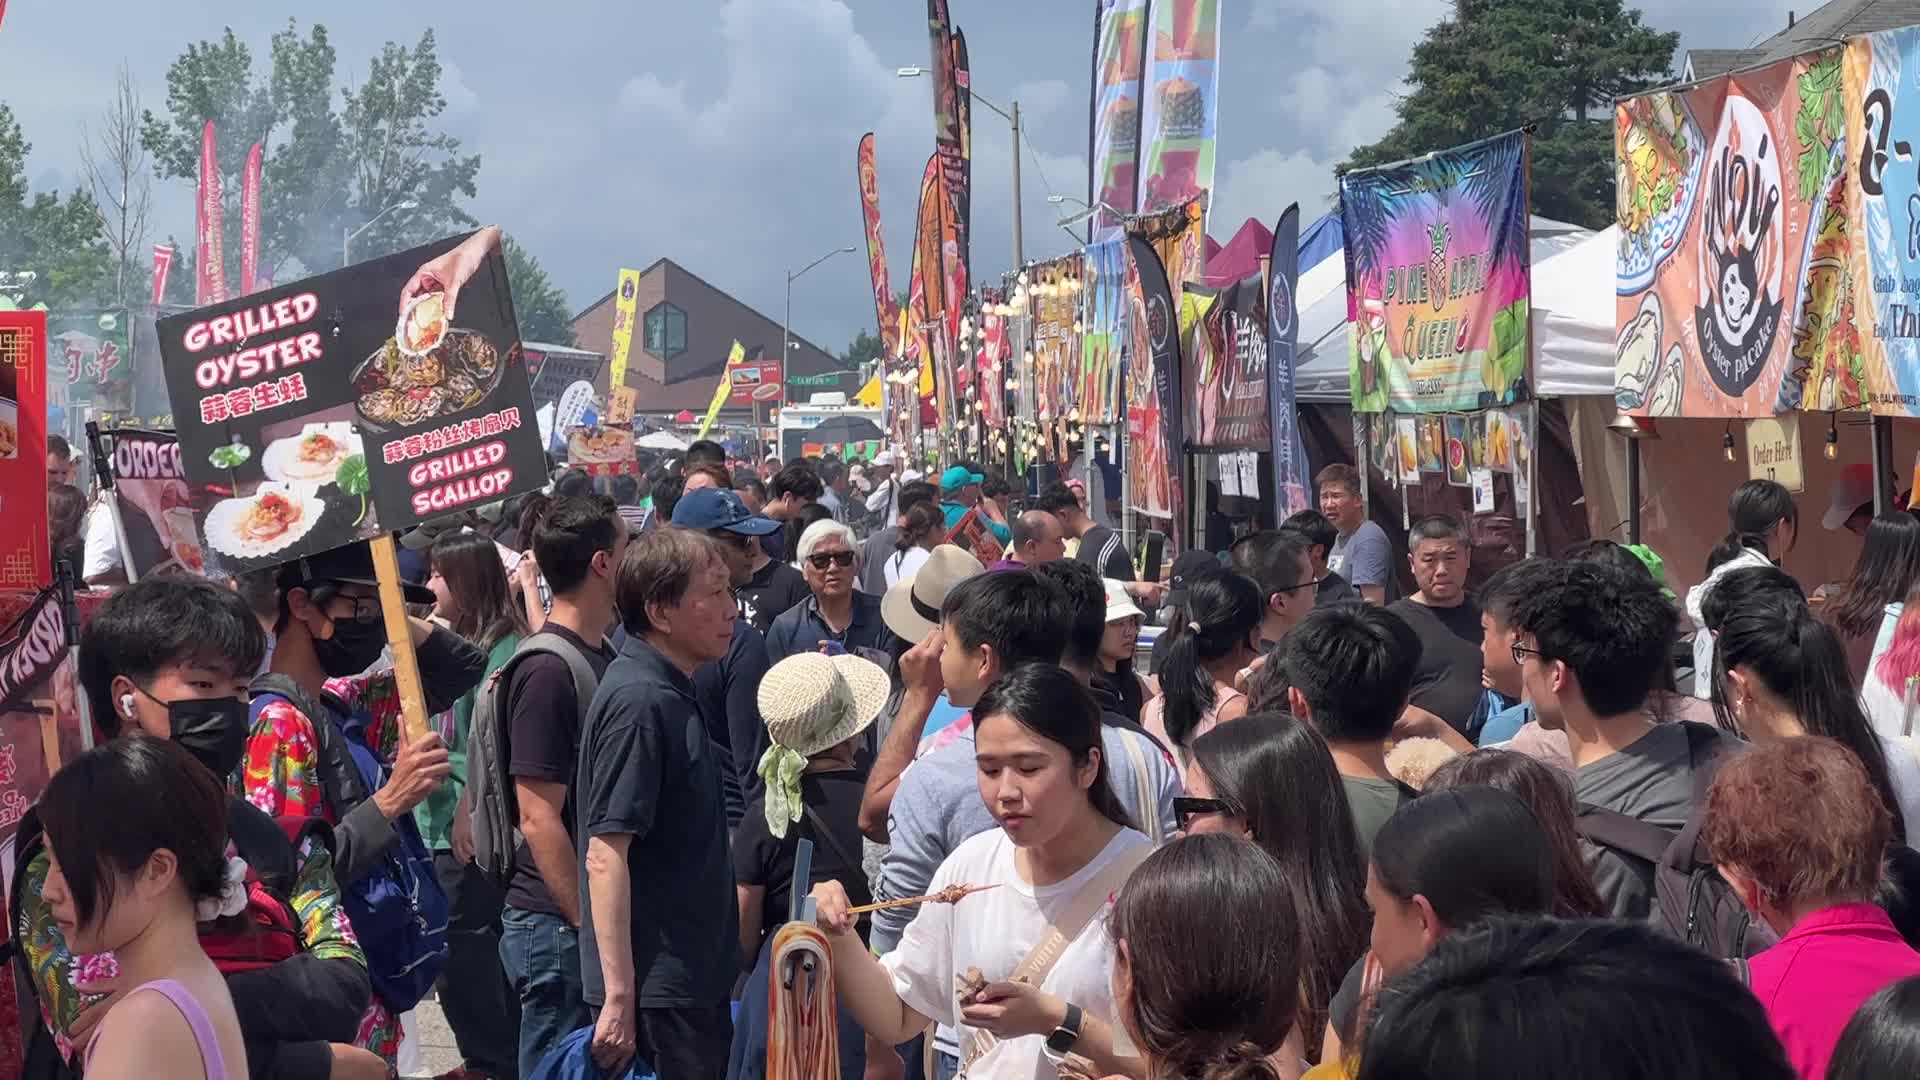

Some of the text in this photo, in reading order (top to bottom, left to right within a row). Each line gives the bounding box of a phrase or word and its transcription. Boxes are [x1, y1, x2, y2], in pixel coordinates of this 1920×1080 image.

[1384, 264, 1428, 305] PINE
[1873, 273, 1896, 294] Grab
[184, 292, 318, 352] GRILLED
[1403, 317, 1458, 365] QUEEN
[196, 332, 323, 388] OYSTER
[1703, 317, 1731, 378] Oyster
[200, 372, 308, 424] 蒜蓉生蚝
[116, 438, 186, 479] ORDER
[382, 406, 522, 464] 蒜蓉粉丝烤扇贝
[1754, 441, 1792, 466] Order Here
[409, 440, 507, 487] GRILLED
[413, 468, 512, 516] SCALLOP
